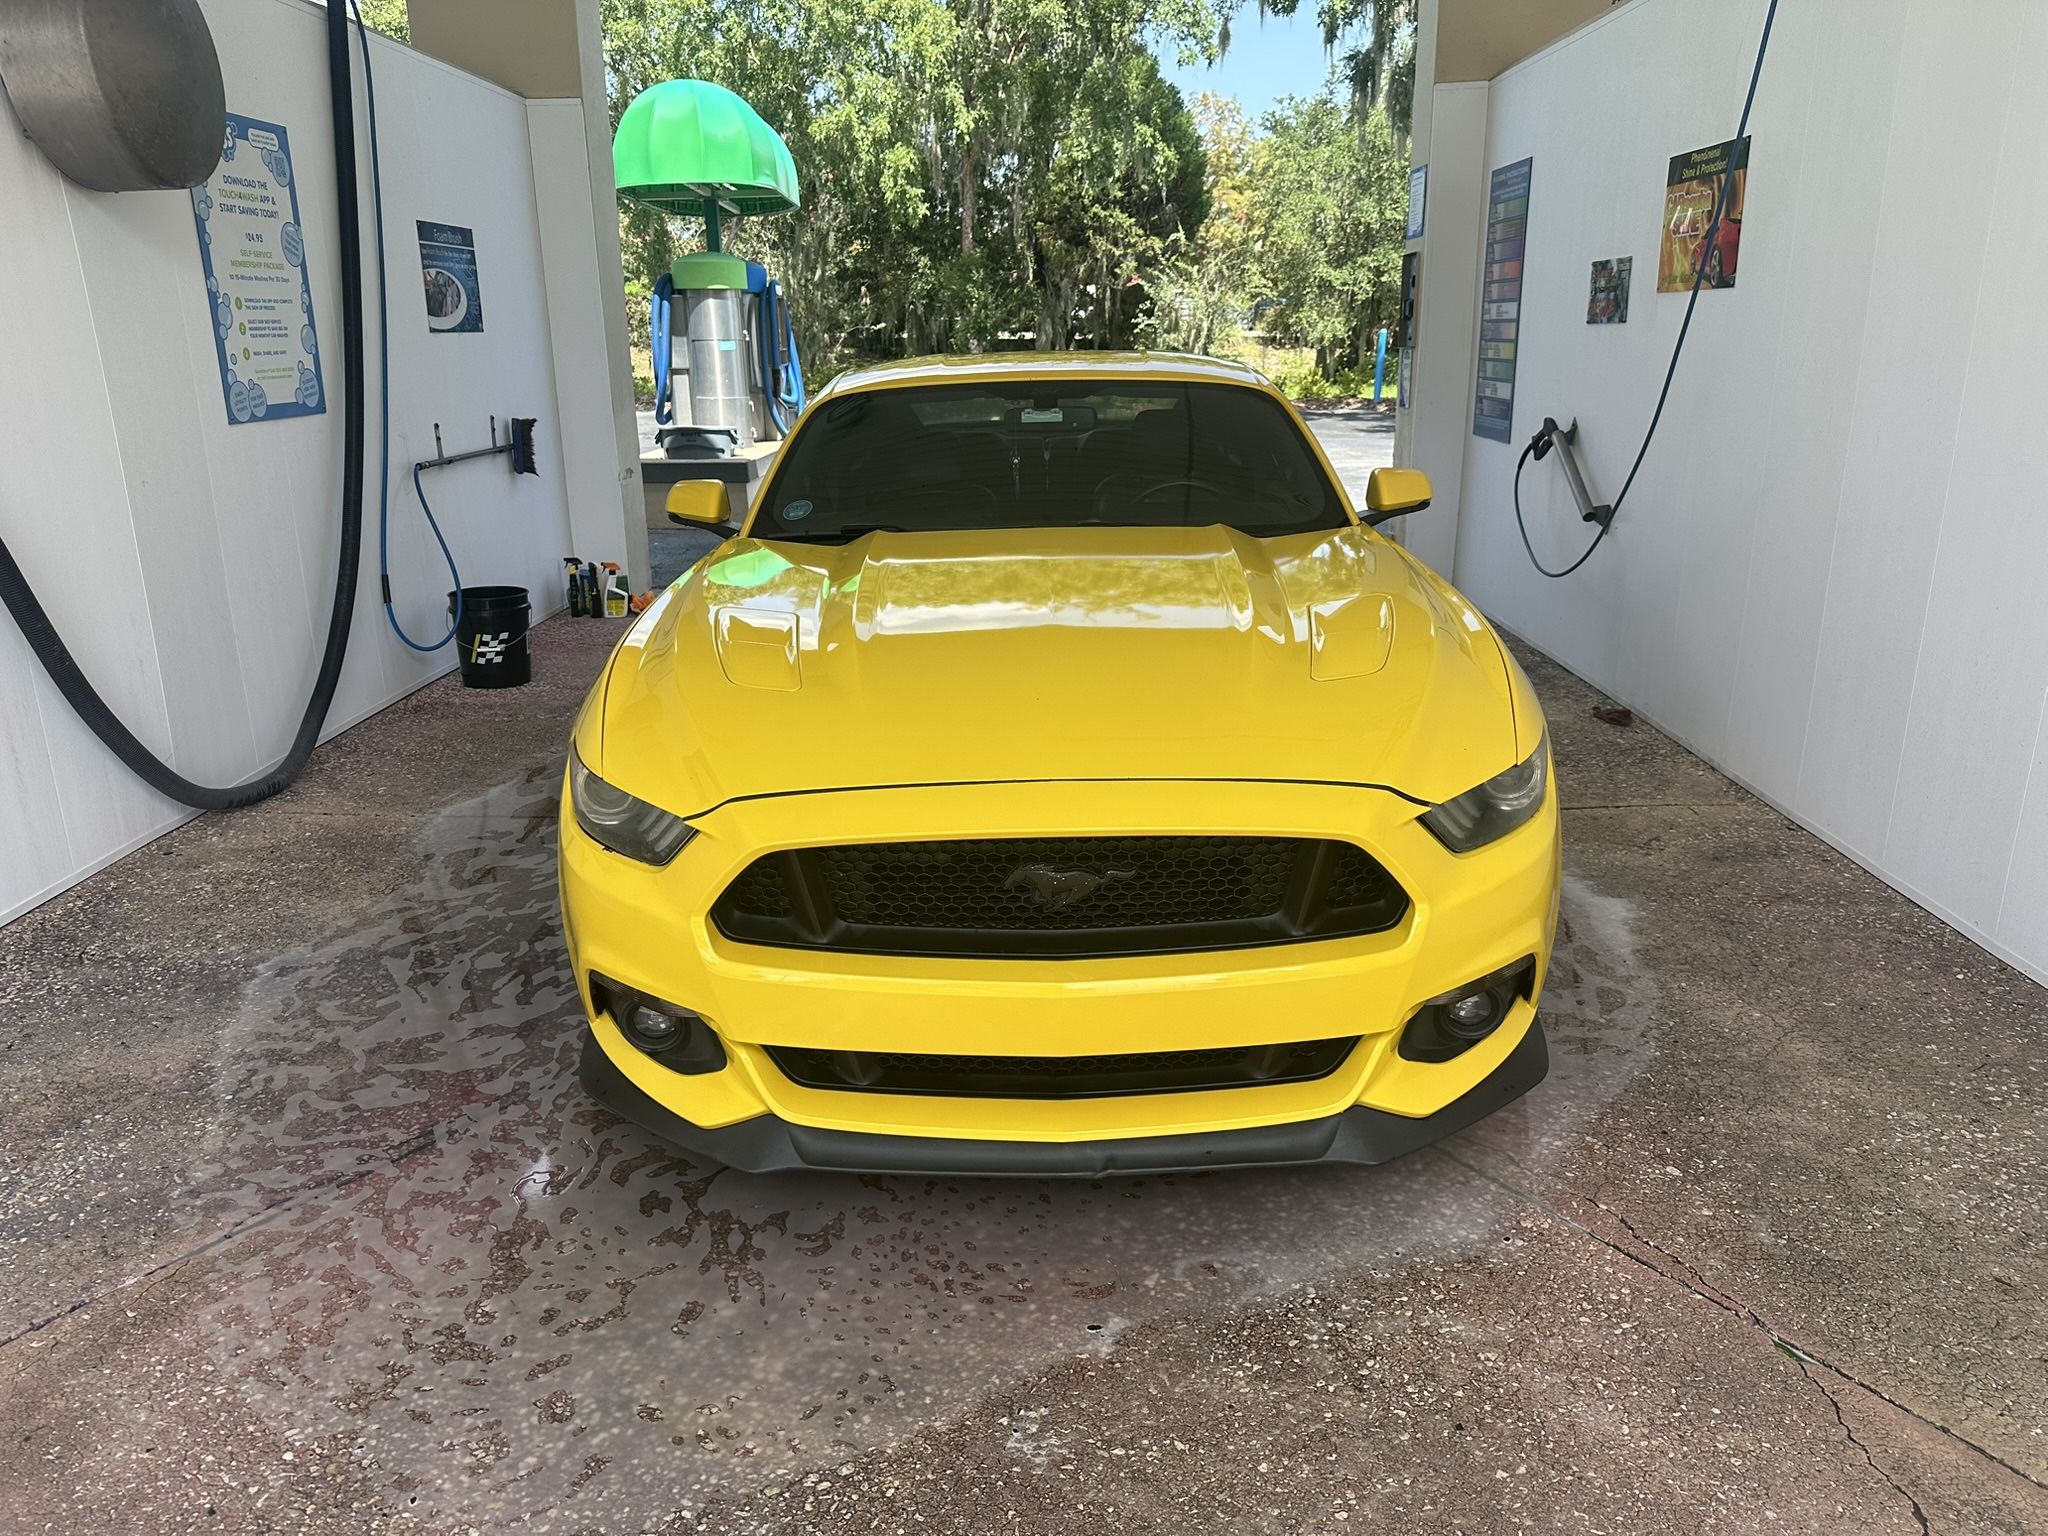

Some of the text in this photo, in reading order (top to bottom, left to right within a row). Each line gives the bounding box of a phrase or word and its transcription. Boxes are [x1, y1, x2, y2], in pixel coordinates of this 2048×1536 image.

[223, 175, 268, 190] DOWNLOAD THE
[218, 188, 276, 205] TOUCH4WASH APP &
[219, 203, 279, 220] START SAVING TODAY!
[245, 233, 264, 243] $24.95
[240, 249, 273, 259] SELF-SERVICE
[230, 260, 285, 270] MEMBERSHIP PACKAGE
